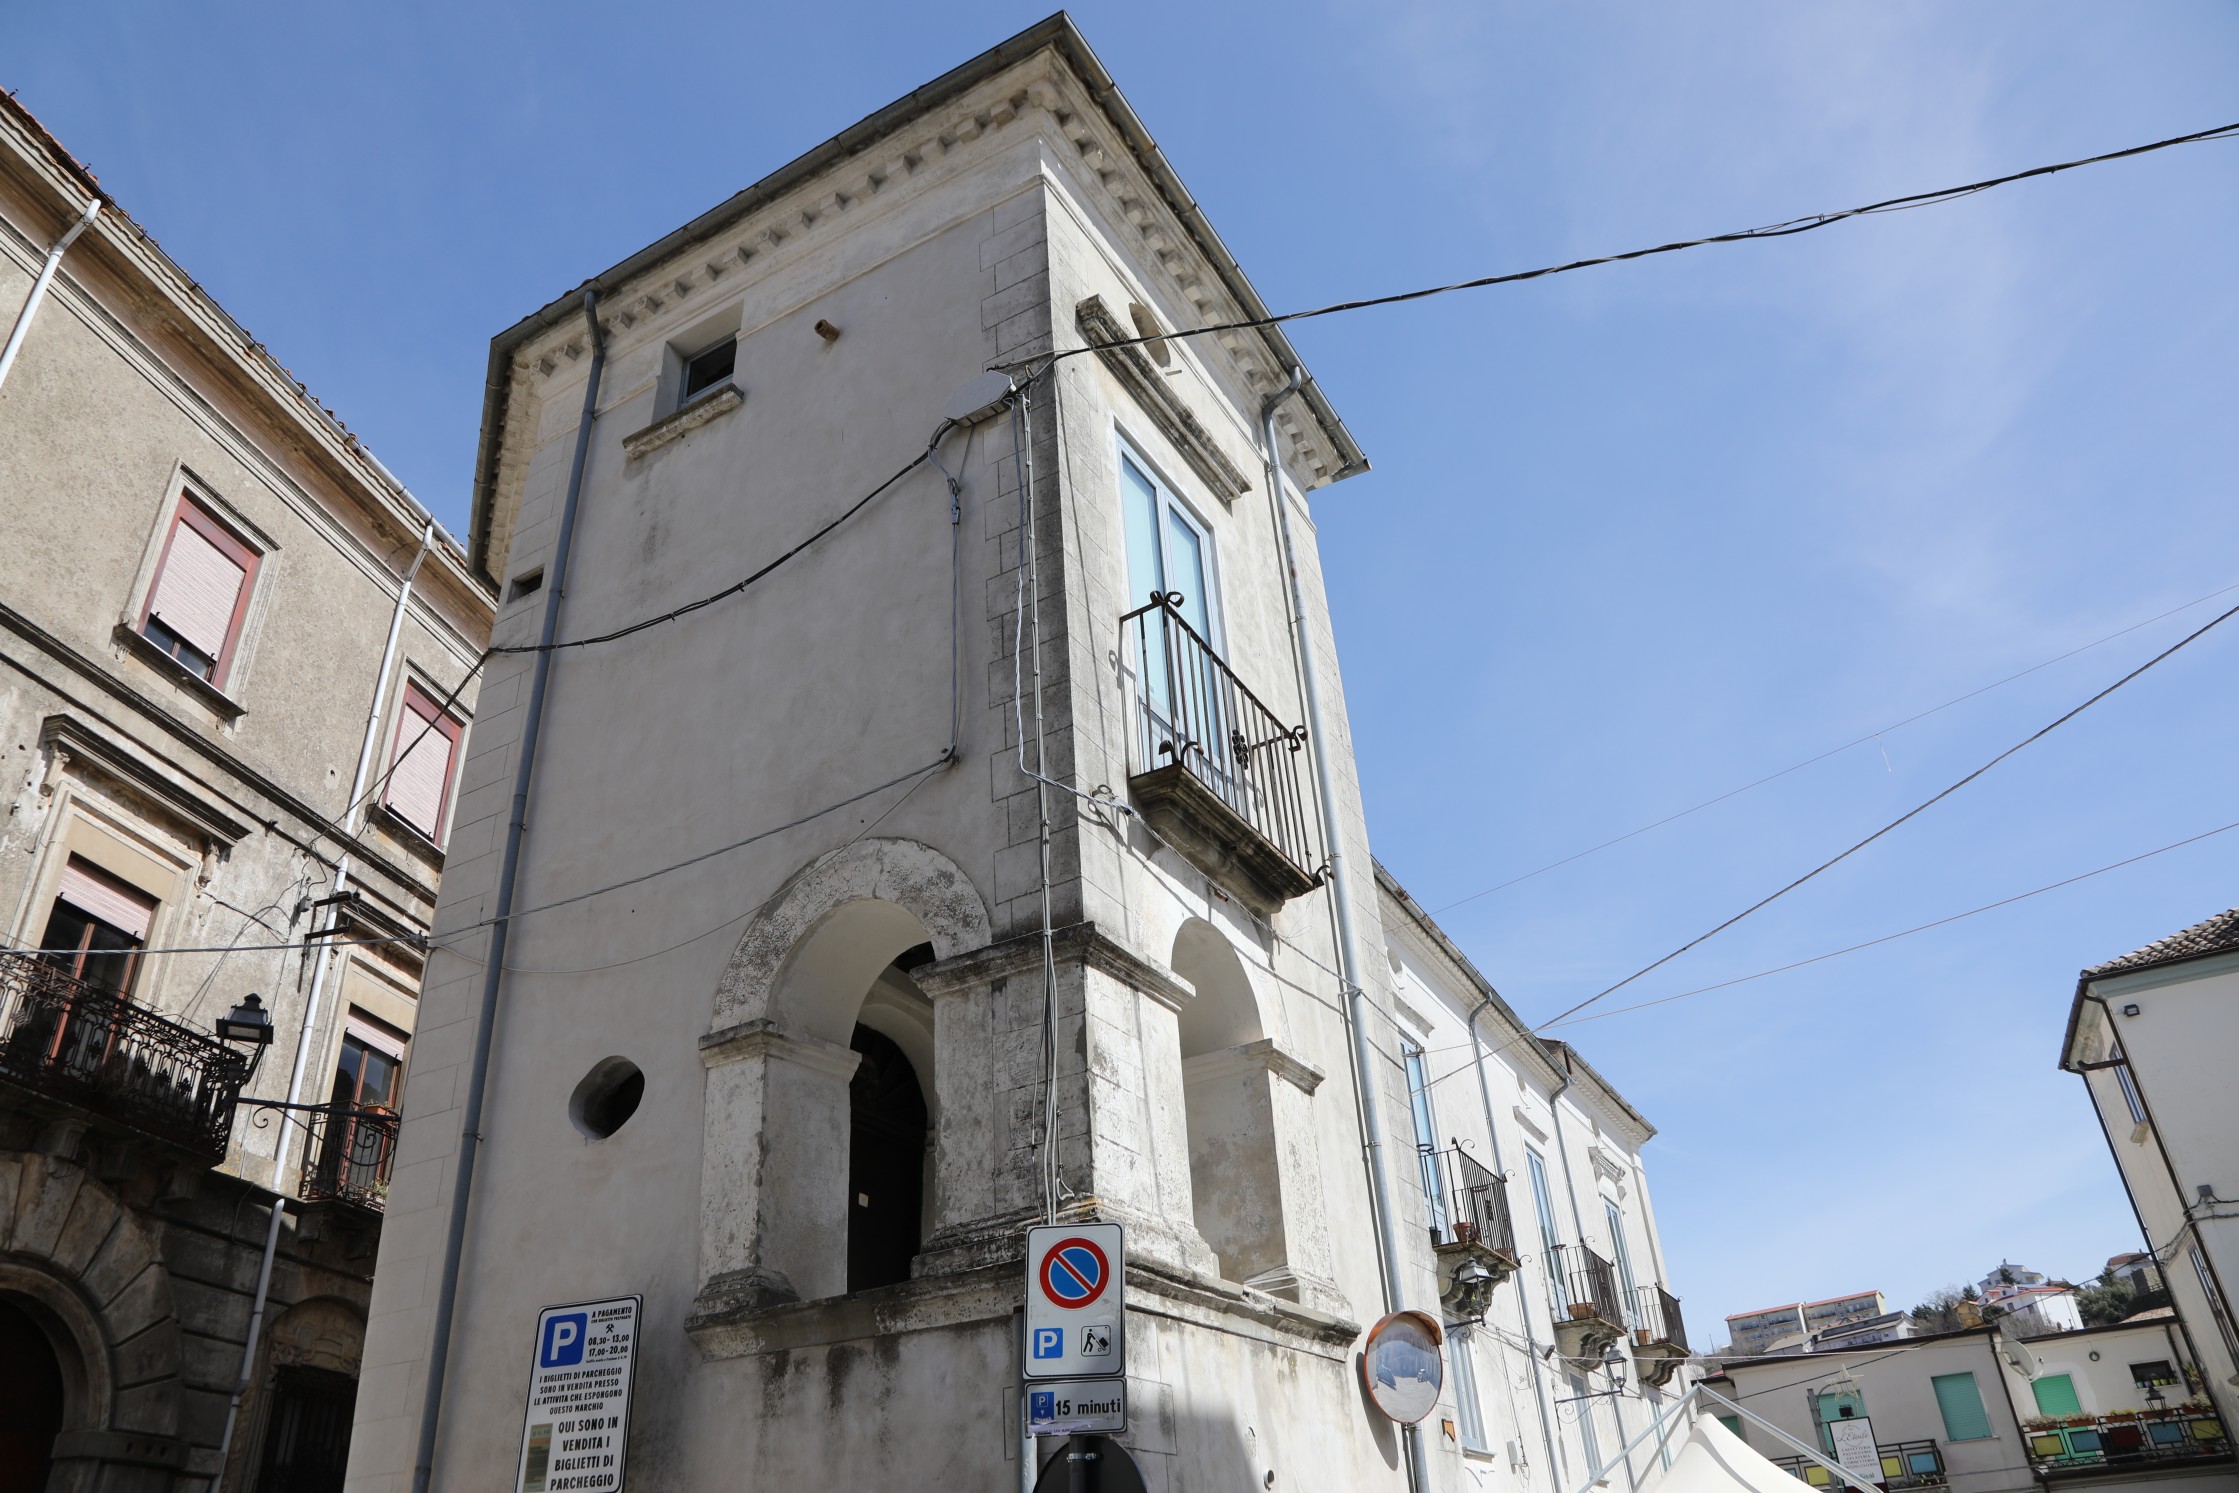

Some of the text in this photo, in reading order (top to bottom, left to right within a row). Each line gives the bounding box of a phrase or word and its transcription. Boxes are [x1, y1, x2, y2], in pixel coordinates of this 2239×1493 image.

[598, 1306, 633, 1317] PAGAMENTO
[550, 1321, 578, 1361] P
[1038, 1331, 1058, 1356] P
[544, 1372, 572, 1382] BIGLIETTI
[573, 1371, 580, 1380] DI
[582, 1367, 622, 1378] PARCHEGGIO
[540, 1378, 619, 1394] SONO IN VENDITA PRESSO
[534, 1389, 622, 1406] LE ATTIVITA CHE ESPONGONO
[549, 1402, 604, 1415] QUESTO MARCHIO
[1056, 1398, 1121, 1415] 15 minuti
[558, 1421, 575, 1434] QUI
[578, 1417, 604, 1432] SONO
[607, 1416, 618, 1429] IN
[562, 1436, 610, 1452] VENDITA I
[554, 1454, 614, 1471] BIGLIETTI DI
[550, 1473, 614, 1491] PARCHEGGIO
